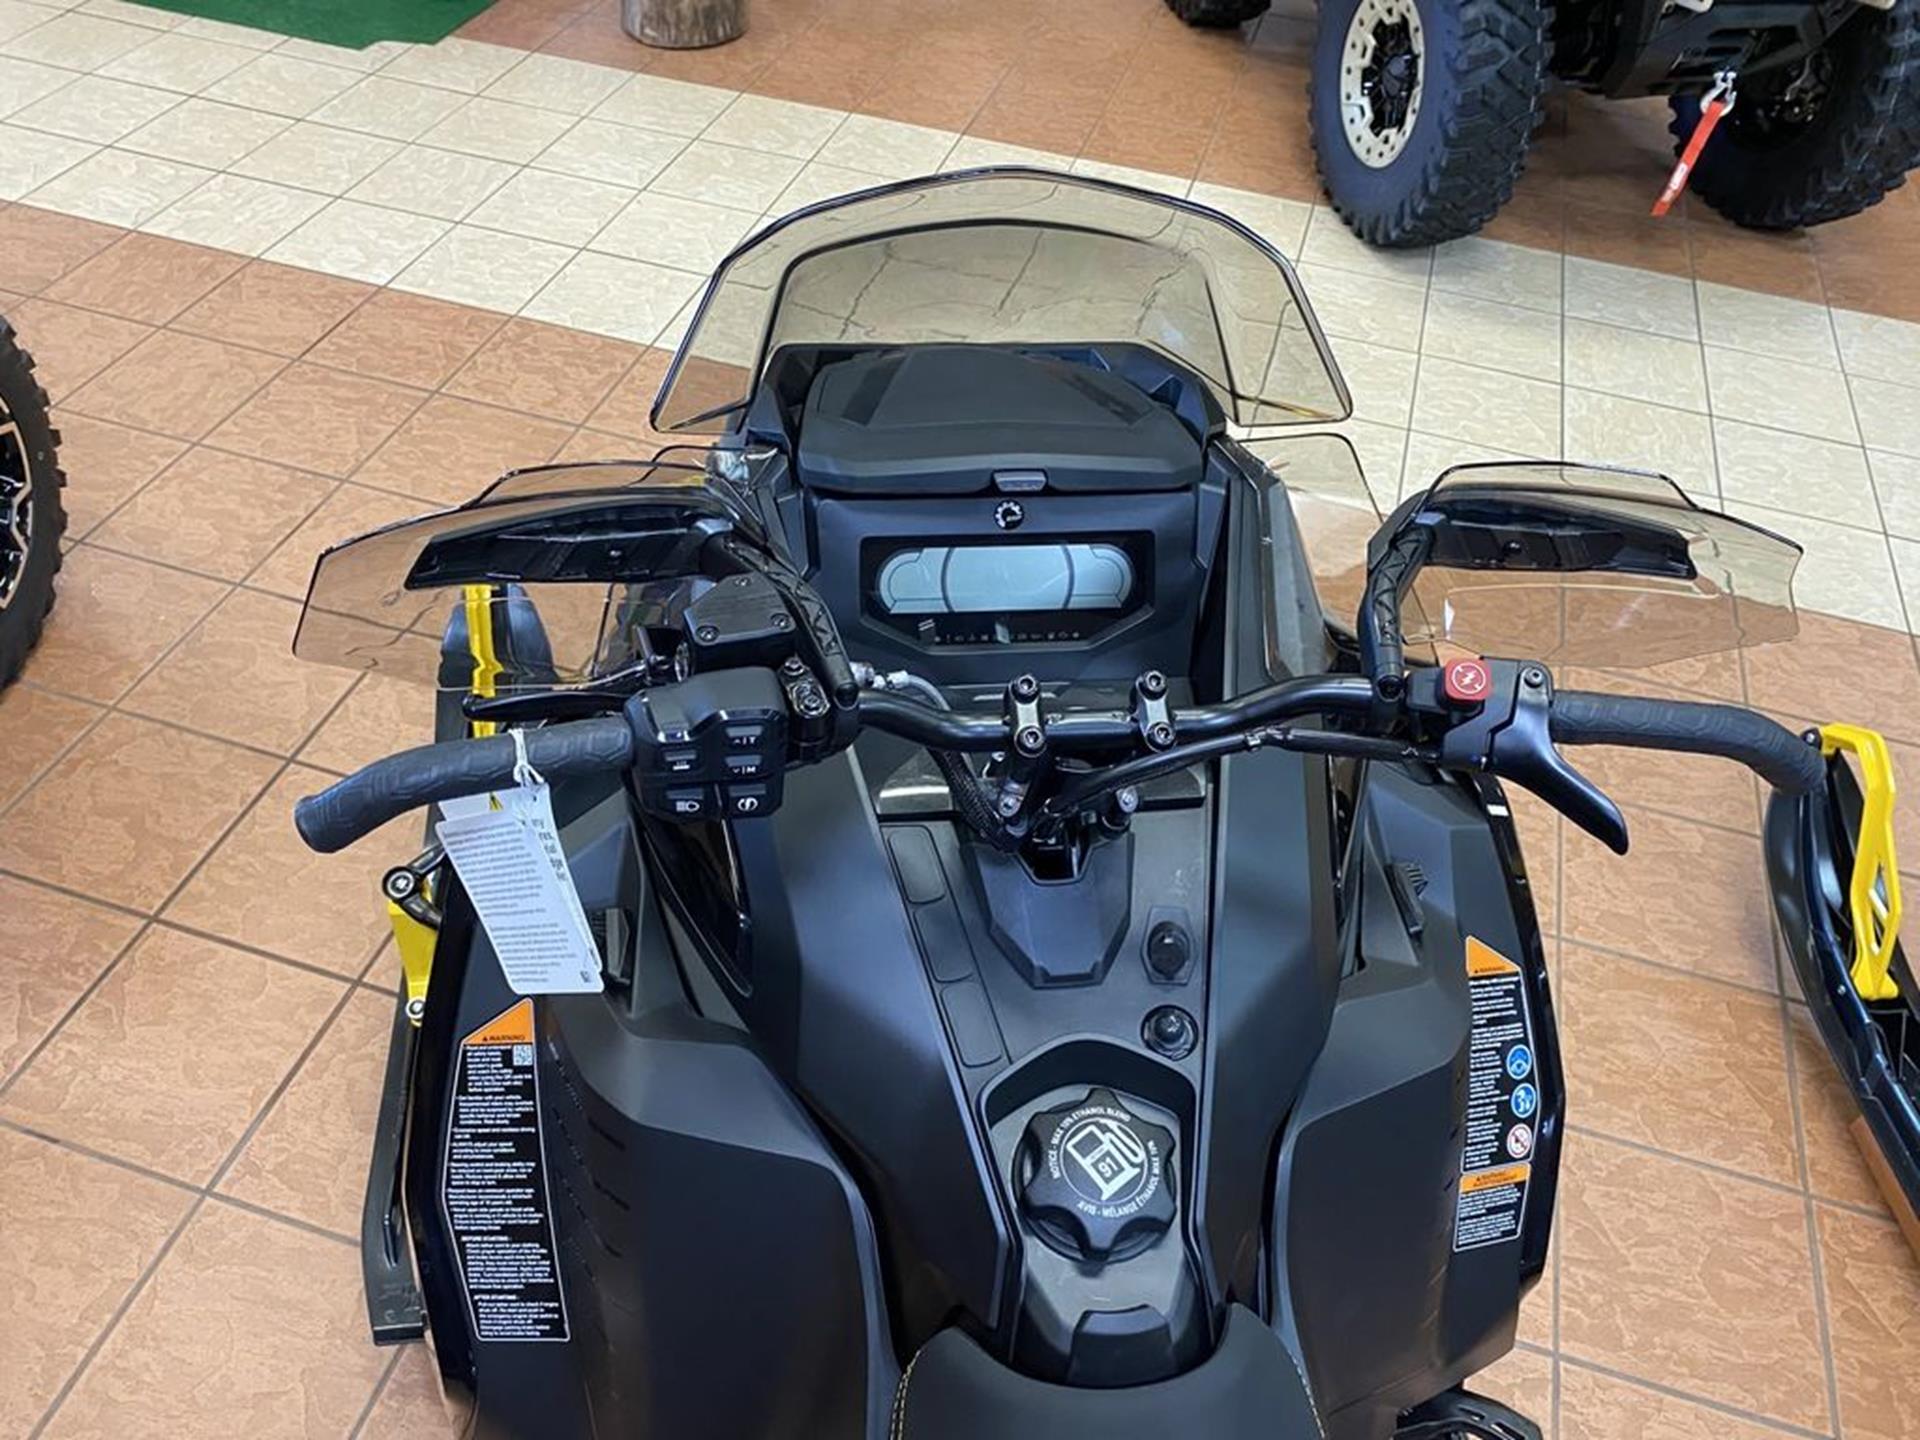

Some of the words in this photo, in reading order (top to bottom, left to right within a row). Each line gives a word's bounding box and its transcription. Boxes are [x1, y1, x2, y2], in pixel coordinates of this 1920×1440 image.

[1071, 1106, 1105, 1120] ETHANOL
[1106, 1107, 1132, 1122] BLEND
[1060, 1116, 1074, 1129] 10%
[1051, 1127, 1064, 1145] MAX
[1048, 1149, 1061, 1179] NOTICE
[1098, 1156, 1118, 1178] 91
[1077, 1200, 1097, 1216] AVIS
